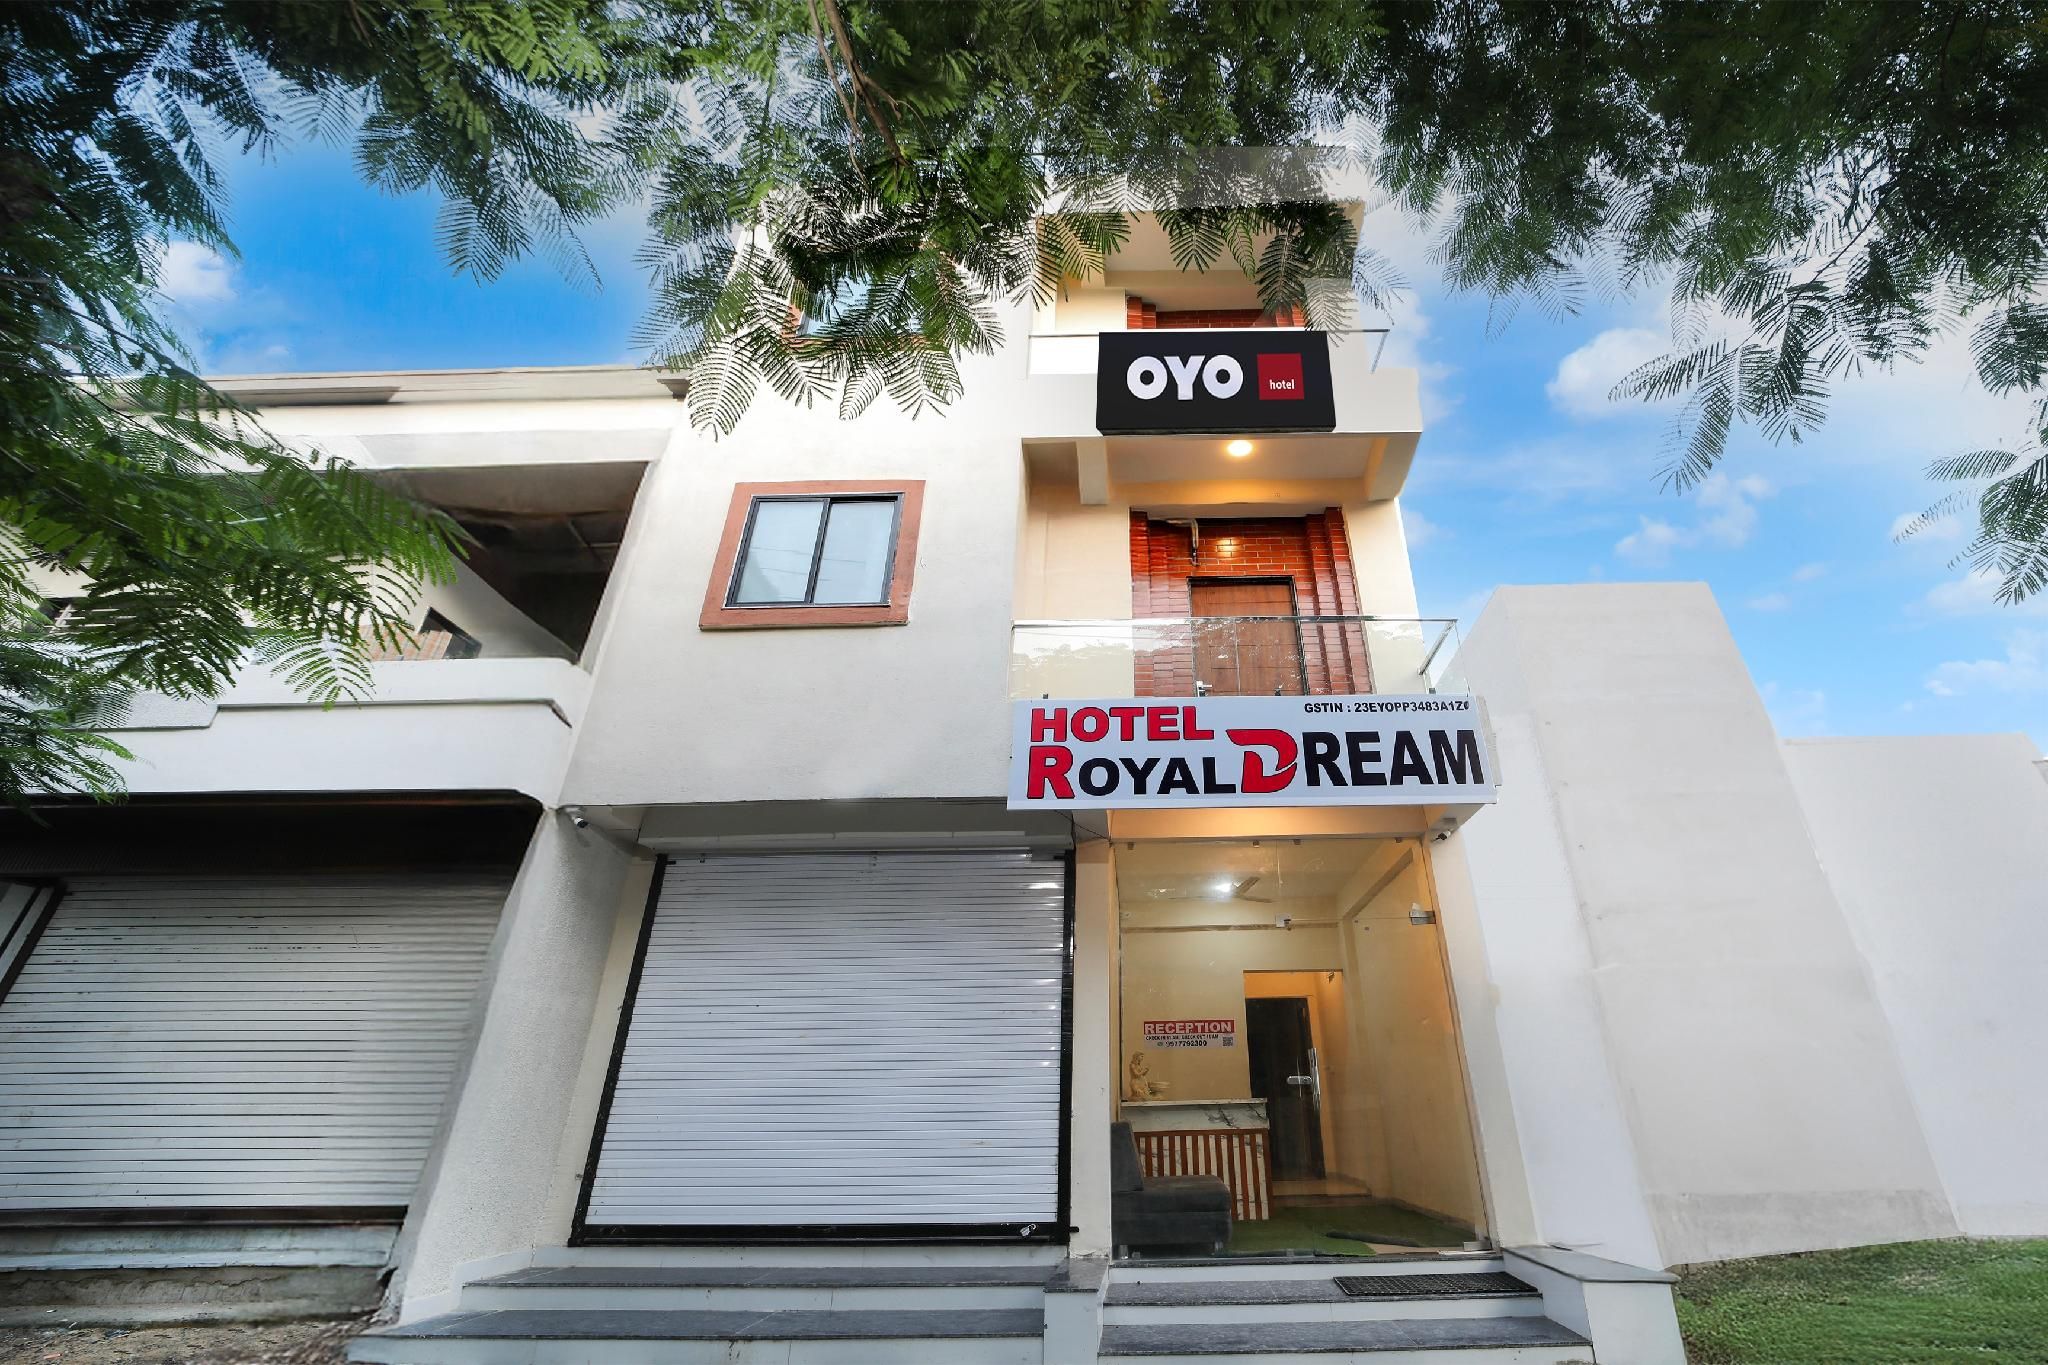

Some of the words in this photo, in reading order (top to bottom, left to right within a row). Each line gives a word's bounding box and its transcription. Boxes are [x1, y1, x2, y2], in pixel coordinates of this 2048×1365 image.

[1126, 354, 1244, 401] OYO
[1269, 378, 1295, 390] hotel
[1304, 702, 1344, 714] GSTIN
[1030, 705, 1215, 743] HOTEL
[1026, 745, 1237, 800] ROYAL
[1226, 728, 1486, 796] DREAM
[1144, 1021, 1232, 1035] RECEPTION
